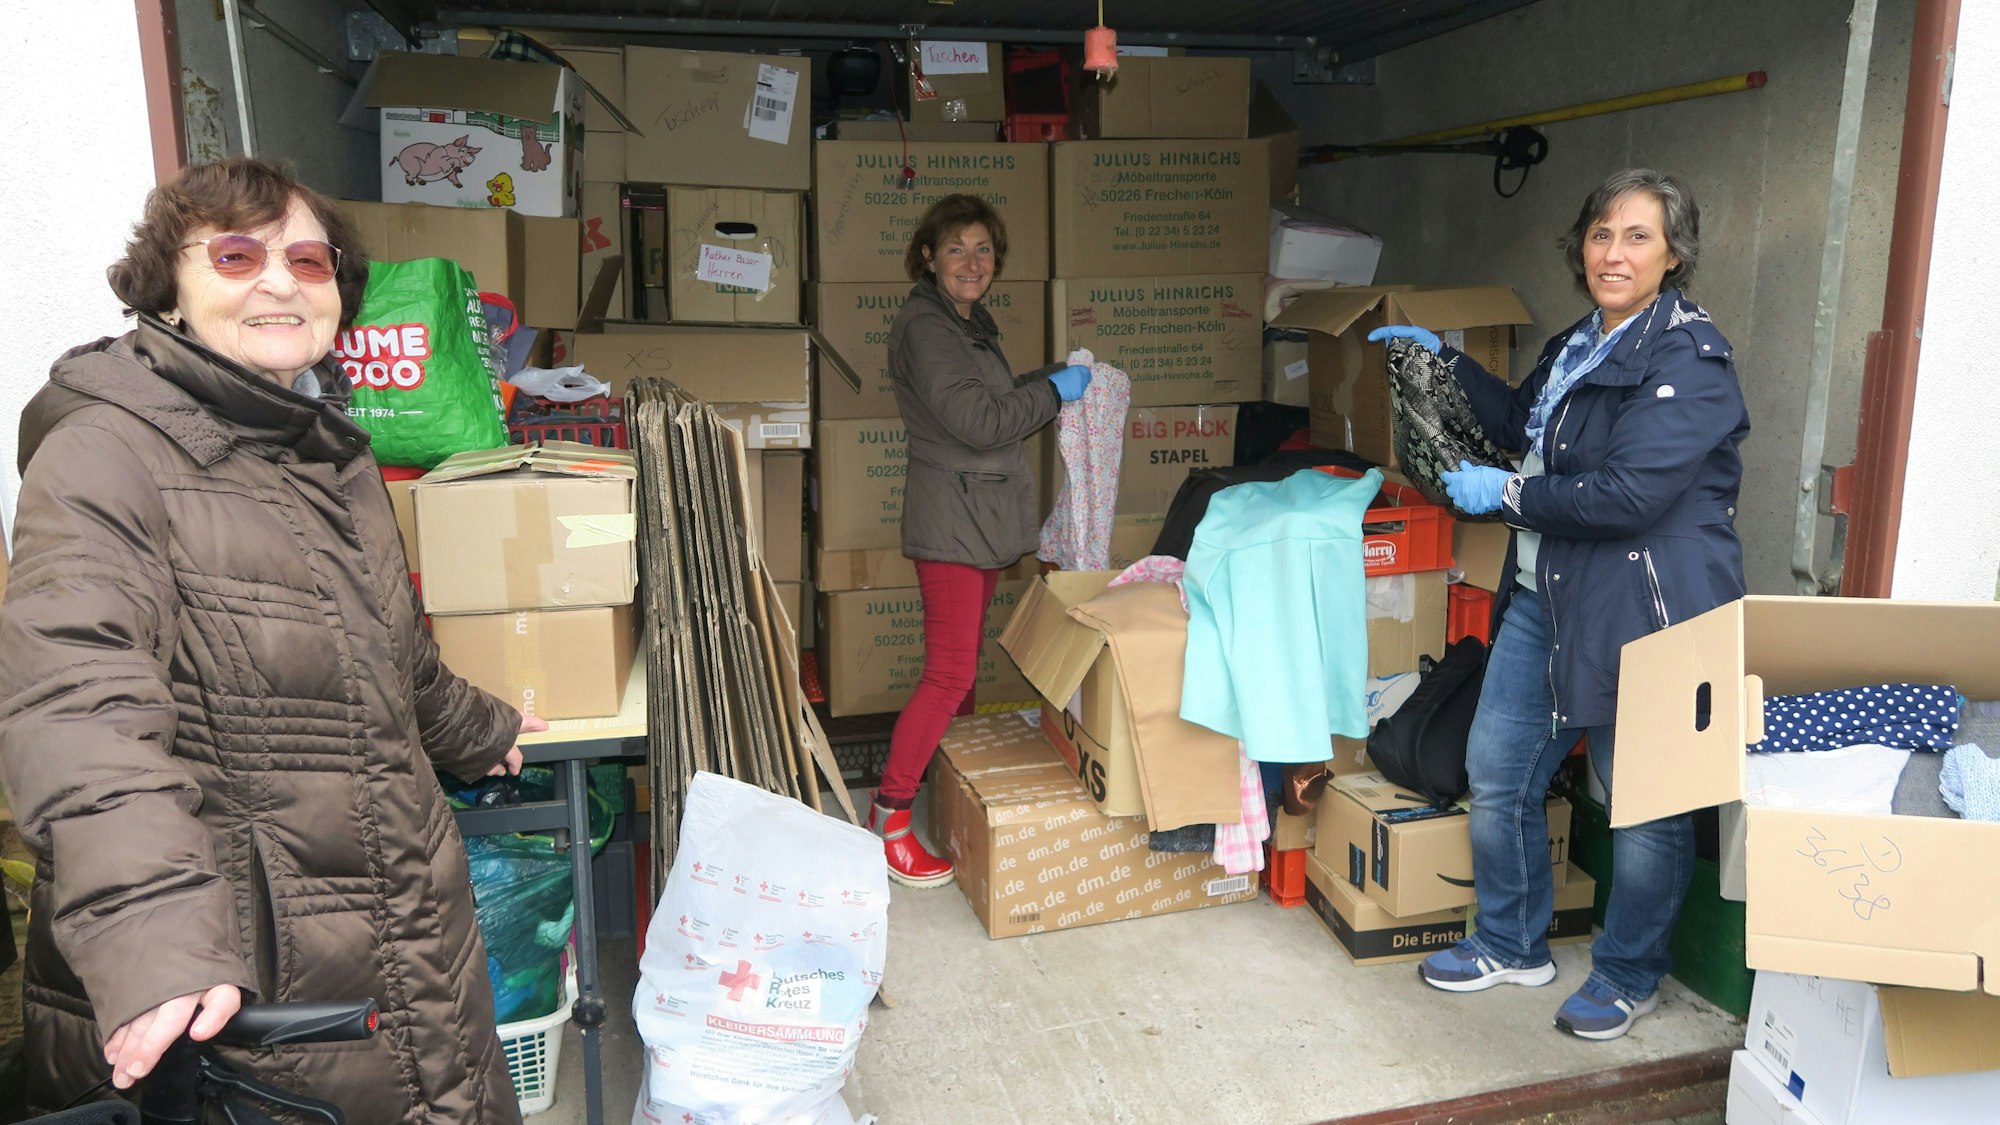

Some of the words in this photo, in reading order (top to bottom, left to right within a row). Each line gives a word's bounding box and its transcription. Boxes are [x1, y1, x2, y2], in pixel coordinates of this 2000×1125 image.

[856, 154, 917, 169] JULIUS
[928, 155, 1015, 170] HINRICHS
[1093, 153, 1150, 167] JULIUS
[1160, 151, 1241, 166] HINRICHS
[883, 174, 989, 187] Meltransporte
[1118, 171, 1217, 185] Möbeltransporte
[864, 193, 907, 205] 50226
[1101, 189, 1141, 202] 50226
[1145, 188, 1233, 201] Frechen-Köln
[1124, 212, 1196, 223] Friedenstraße
[1114, 227, 1131, 237] Tel.
[1148, 226, 1160, 236] 22
[1164, 225, 1179, 236] 34)
[1207, 225, 1220, 235] 24
[1113, 240, 1221, 251] www.Julius-Hinrichs.de
[707, 262, 744, 281] Herren
[1089, 288, 1145, 303] JULIUS
[1154, 285, 1234, 300] HINRICHS
[856, 295, 905, 309] JULIU
[1114, 305, 1210, 318] Möbeltransporte
[1096, 324, 1136, 336] 50226
[1140, 321, 1226, 334] Frechen-Köln
[329, 326, 427, 359] LUME
[864, 332, 888, 344] 502
[1119, 345, 1188, 355] Friedenstraße
[1192, 343, 1203, 352] 64
[624, 347, 671, 371] XS
[1143, 359, 1155, 368] 22
[1158, 358, 1173, 369] 34)
[1185, 357, 1198, 366] 23
[1200, 356, 1212, 365] 24
[1128, 371, 1214, 382] .Julius-Hinrichs.de
[345, 407, 367, 417] EIT
[369, 408, 395, 418] 1974
[1132, 421, 1168, 439] BIG
[1173, 419, 1229, 438] PACK
[859, 430, 909, 444] JULIU
[1150, 448, 1209, 465] STAPEL
[881, 501, 900, 511] Tel.
[866, 601, 924, 615] JULIUS
[874, 634, 915, 646] 50226
[888, 668, 908, 679] Tel.
[995, 804, 1031, 823] dm.de
[1044, 808, 1087, 831] dm.de
[1080, 819, 1124, 842] dm.de
[1027, 838, 1070, 861] dm.de
[1099, 833, 1150, 861] dm.de
[1038, 856, 1089, 884] dm.de
[1077, 865, 1132, 895] dm.de
[1116, 878, 1162, 904] dm.de
[1152, 889, 1192, 912] dm.de
[1057, 901, 1105, 927] dm.de
[1392, 934, 1418, 949] Die
[1422, 930, 1464, 945] Ernte
[766, 997, 812, 1010] Kreuz
[707, 1015, 845, 1043] KLEIDERSAMMLUNG
[690, 1070, 729, 1083] Herzlichen
[731, 1077, 750, 1087] Dank
[752, 1080, 763, 1088] für
[765, 1083, 779, 1092] Ihre
